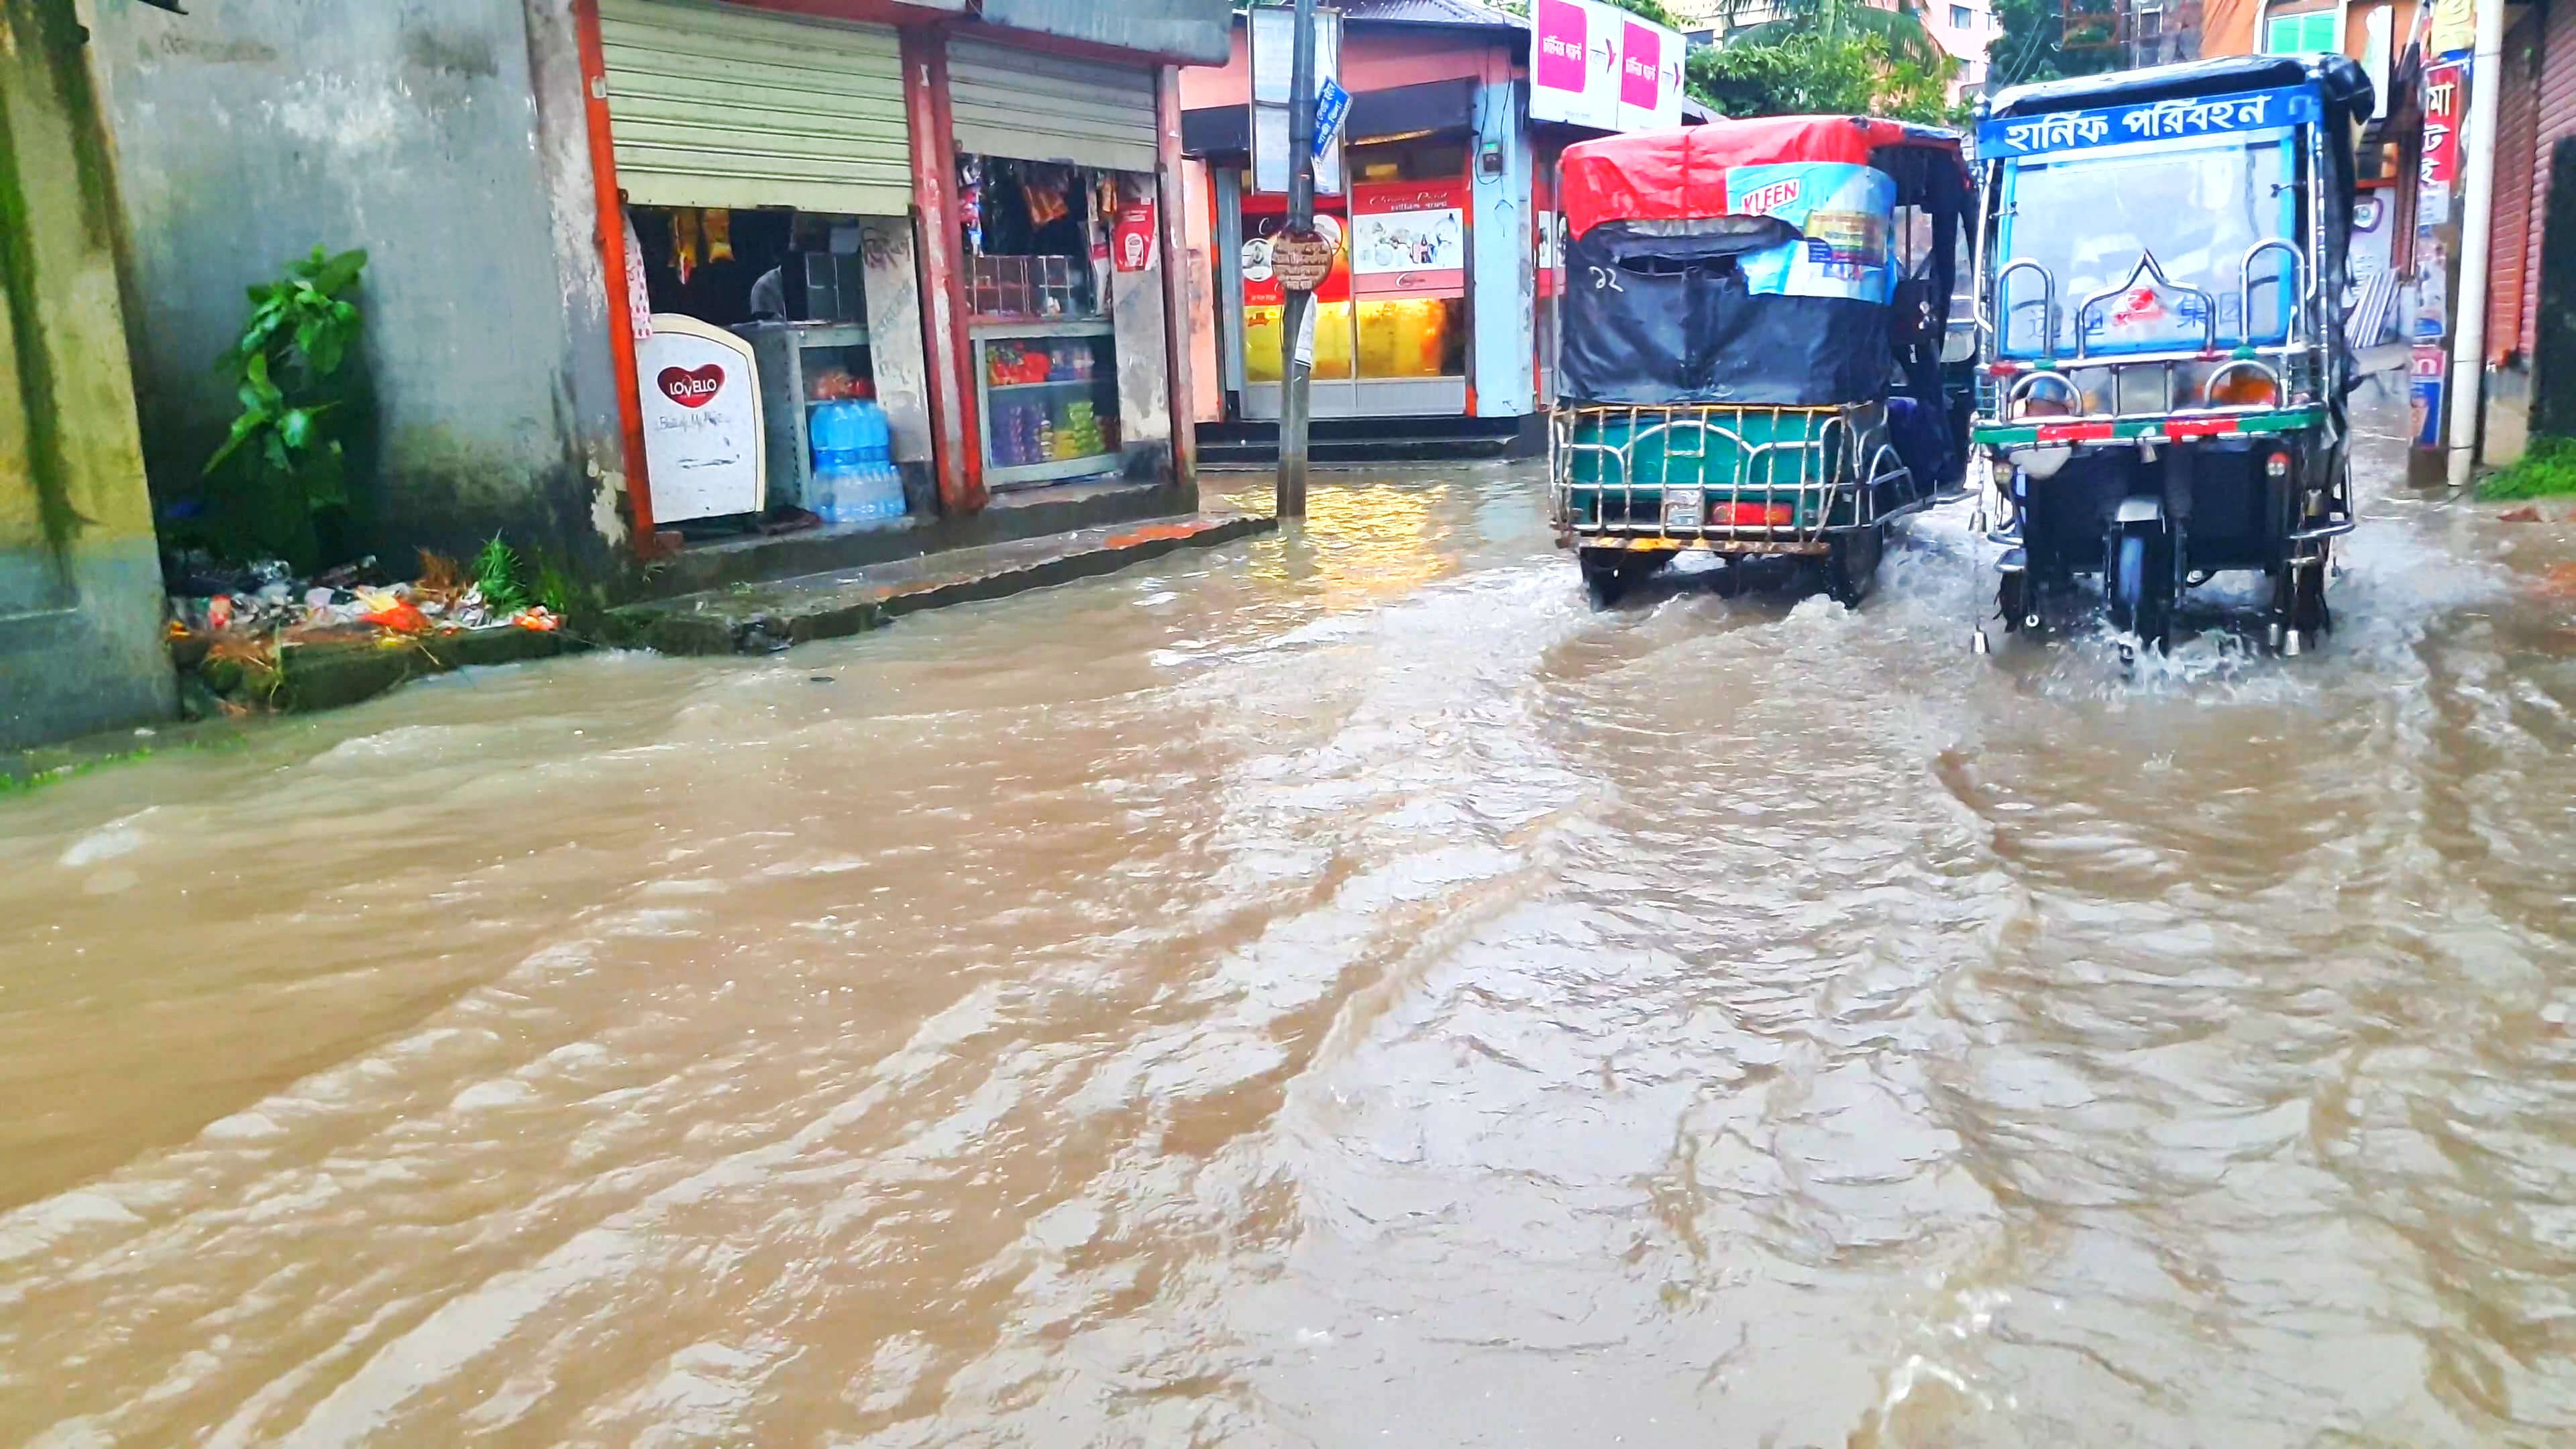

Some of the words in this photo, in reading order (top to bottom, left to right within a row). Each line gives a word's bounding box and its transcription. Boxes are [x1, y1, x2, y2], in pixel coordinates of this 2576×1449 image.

[2121, 95, 2273, 137] পরিবহন
[1743, 182, 1796, 215] KLEEN
[669, 378, 716, 397] LOVELLO
